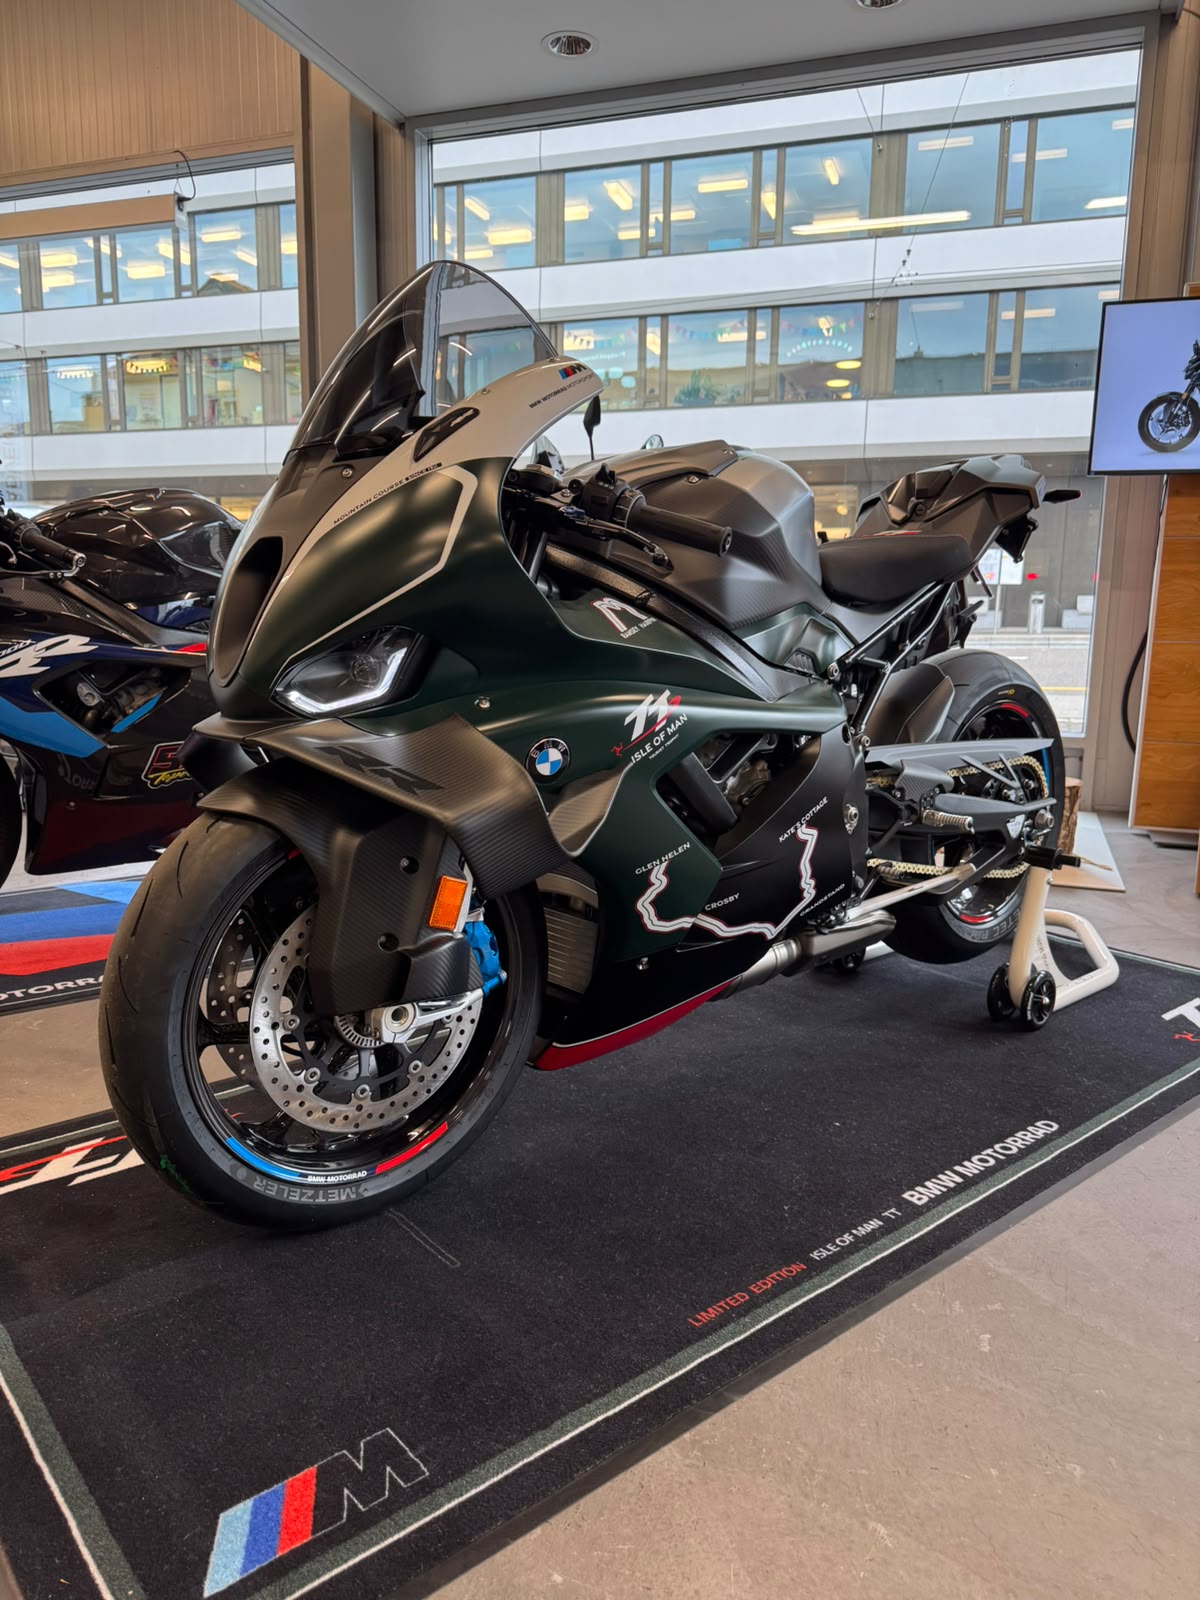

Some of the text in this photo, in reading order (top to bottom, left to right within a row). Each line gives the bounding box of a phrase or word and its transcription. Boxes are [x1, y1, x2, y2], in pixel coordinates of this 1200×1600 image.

[529, 399, 542, 408] BMW
[541, 386, 568, 402] MOTORRAD
[333, 498, 372, 525] MOUNTAIN
[373, 479, 404, 499] COURSE
[631, 712, 688, 764] ISLE OF MAN
[778, 796, 828, 843] KATE'S COTTAGE
[661, 841, 691, 862] HELEN
[704, 892, 740, 911] CROSBY
[253, 1176, 357, 1203] METZELER
[307, 1169, 367, 1183] BMW MOTORRAD
[687, 1119, 1060, 1329] LIMITED EDITION ISLE OF MAN TT BMW MOTORRAD
